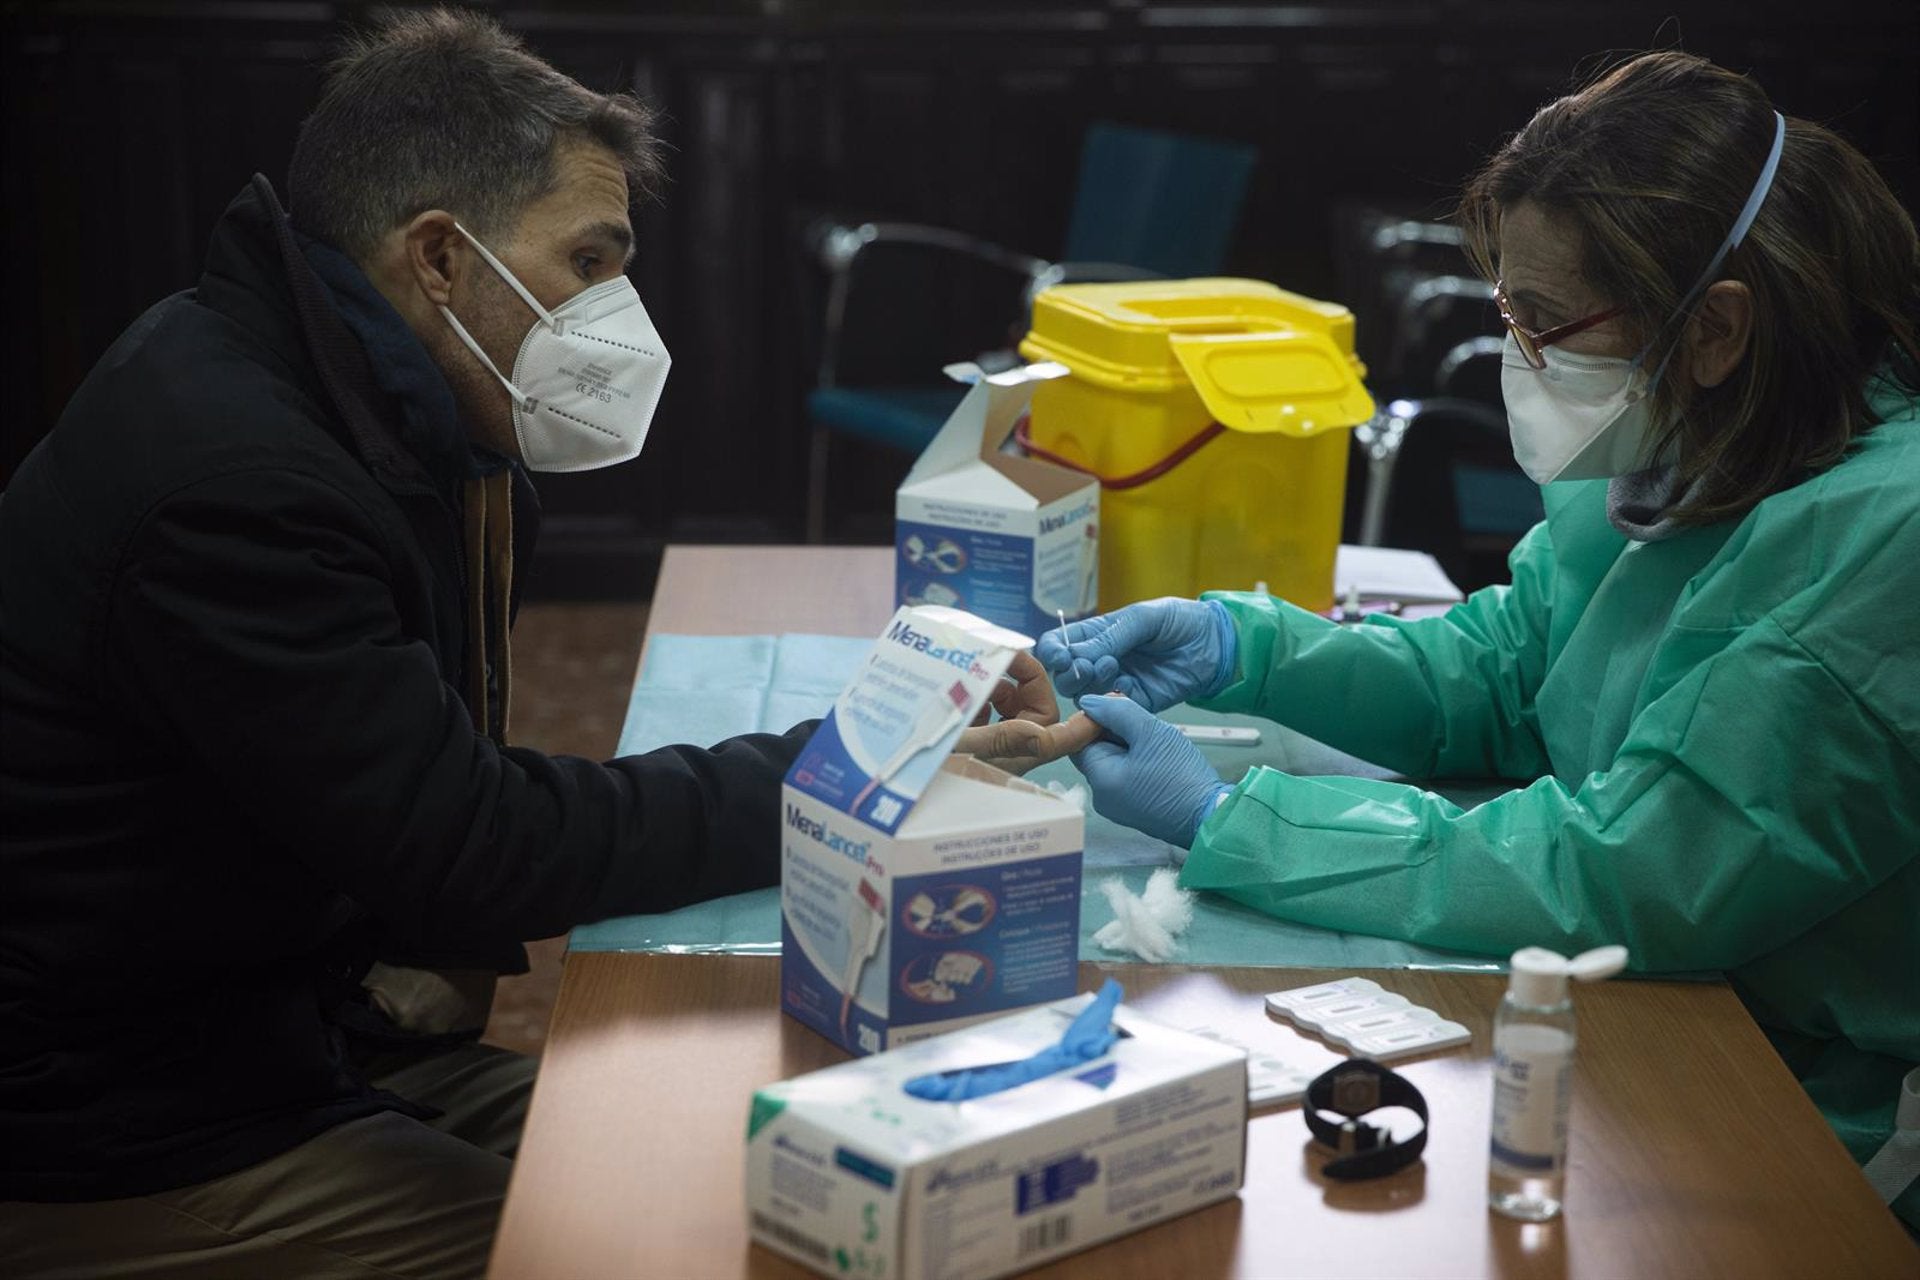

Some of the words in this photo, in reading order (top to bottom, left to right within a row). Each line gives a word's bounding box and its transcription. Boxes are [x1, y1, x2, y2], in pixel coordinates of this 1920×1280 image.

[587, 387, 612, 403] 2163
[1011, 831, 1026, 841] DE
[1027, 828, 1049, 840] USO
[1005, 845, 1018, 856] DE
